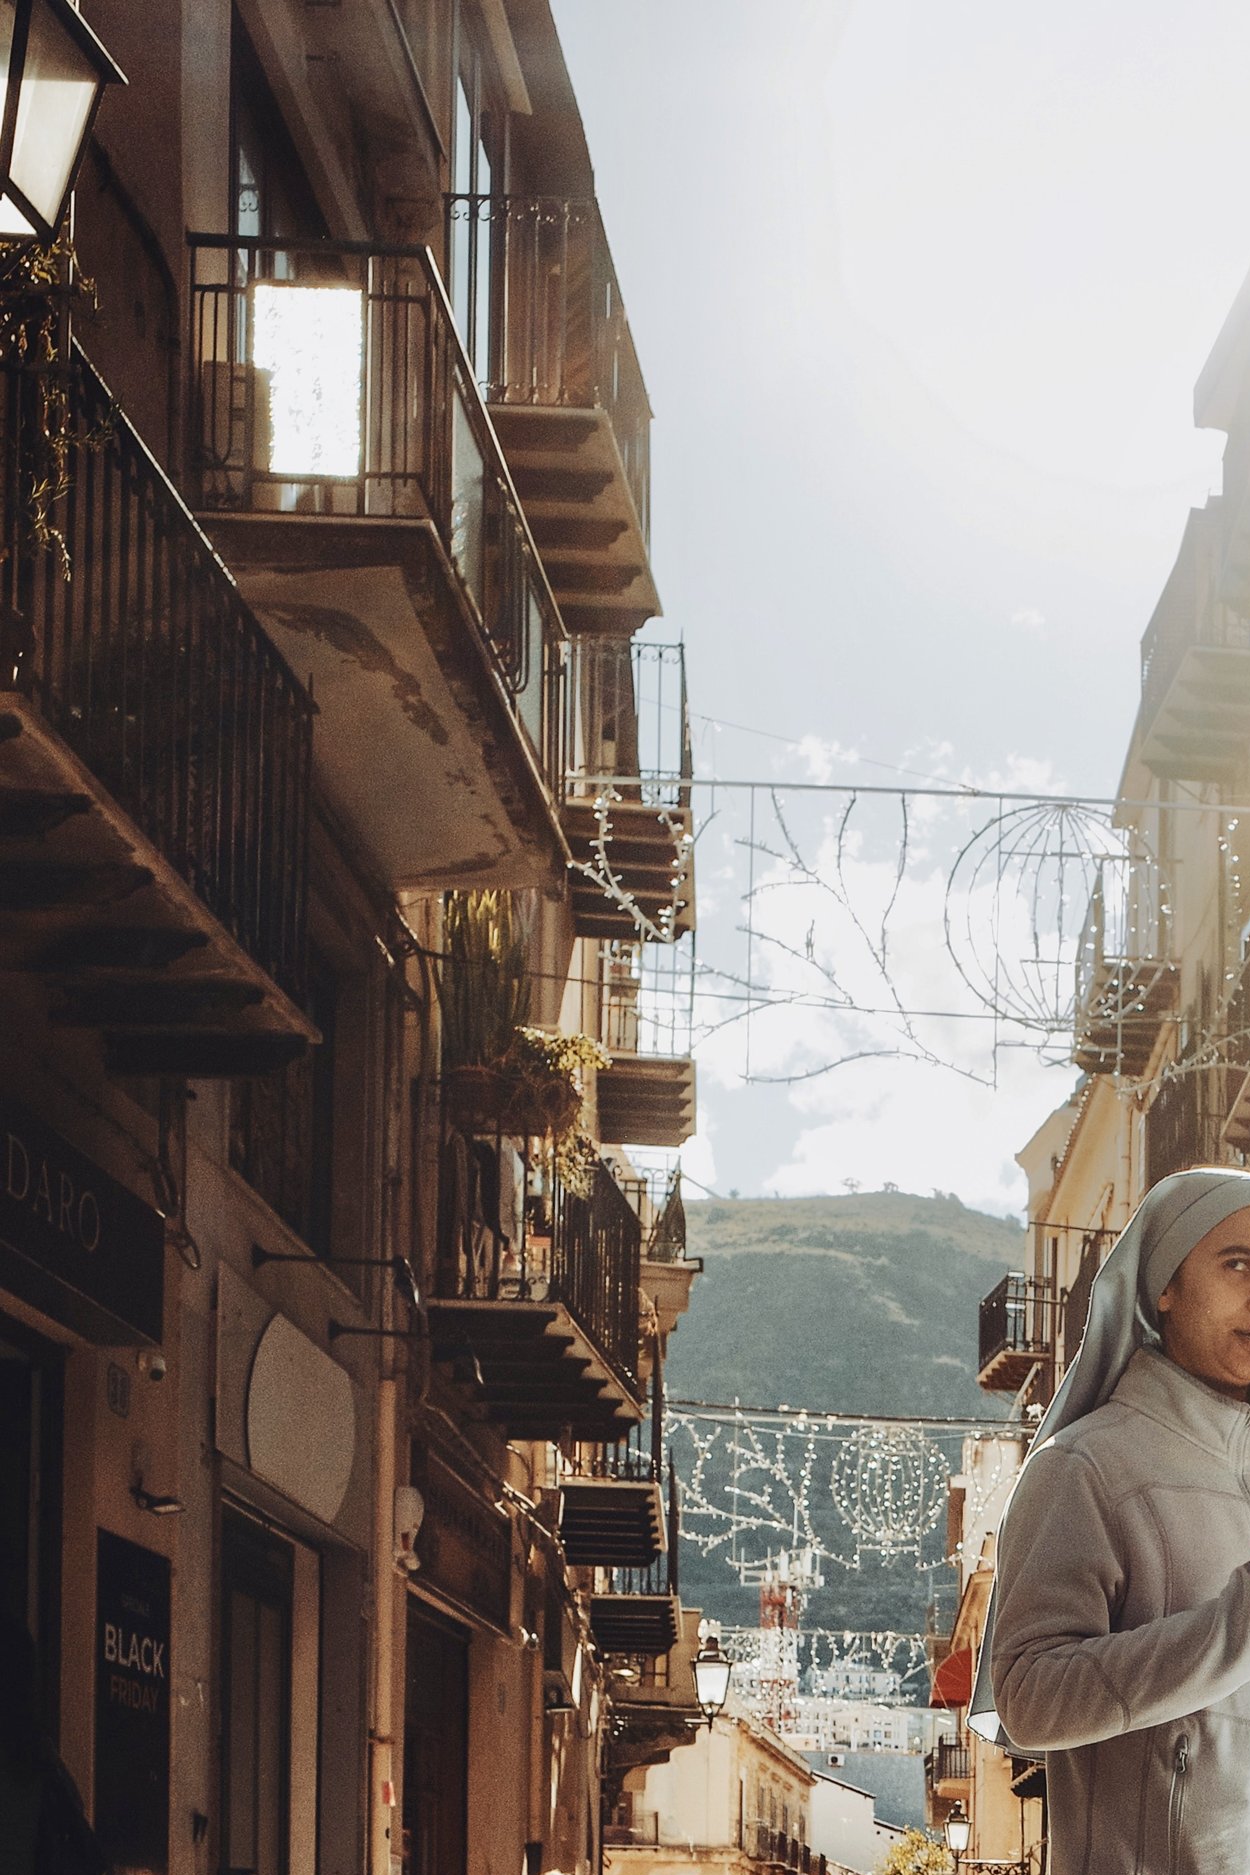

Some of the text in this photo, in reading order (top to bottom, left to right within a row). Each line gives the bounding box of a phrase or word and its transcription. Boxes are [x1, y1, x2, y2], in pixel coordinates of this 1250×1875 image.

[6, 1131, 101, 1253] DARO
[104, 1622, 165, 1679] BLACK
[109, 1674, 160, 1713] FRIDAY
